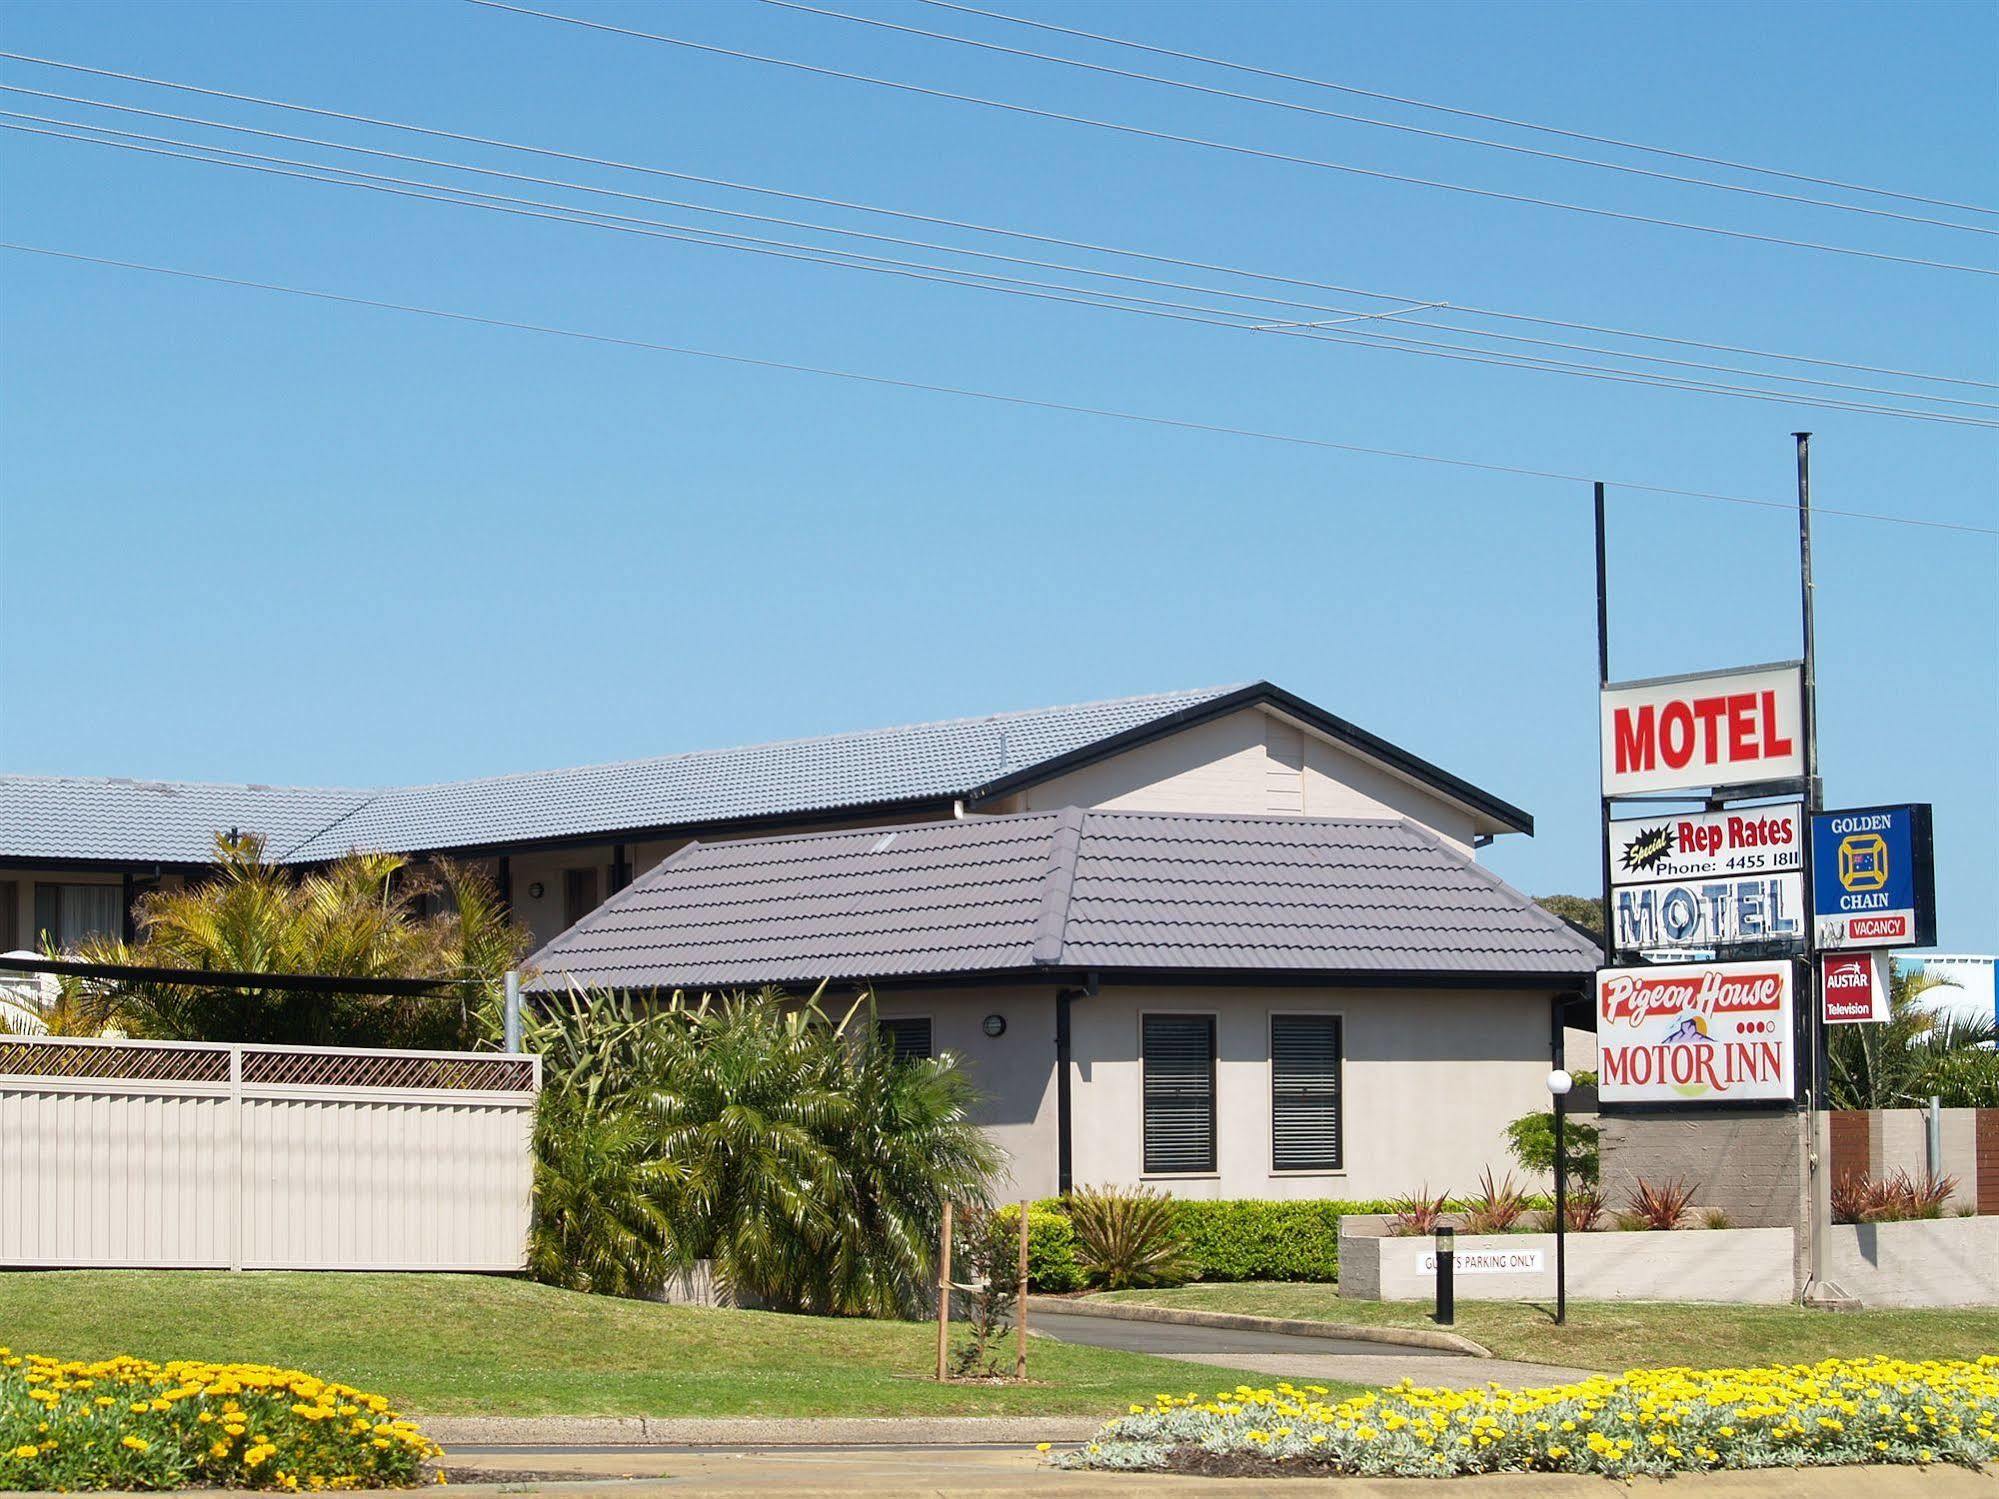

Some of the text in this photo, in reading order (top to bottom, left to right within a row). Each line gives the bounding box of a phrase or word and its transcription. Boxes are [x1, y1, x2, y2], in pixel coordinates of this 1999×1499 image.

[1614, 689, 1793, 775] MOTEL
[1677, 814, 1793, 857] Rep Rates
[1831, 814, 1892, 834] GOLDEN
[1629, 831, 1668, 865] Special
[1656, 852, 1798, 876] Phone: 4455 1811
[1618, 879, 1799, 944] MOTEL
[1839, 892, 1889, 910] CHAIN
[1853, 919, 1902, 936] VACANCY
[1827, 973, 1868, 988] AUSTAR
[1607, 971, 1784, 1028] Pigeon House
[1827, 1003, 1870, 1015] Television
[1601, 1041, 1783, 1091] MOTOR INN
[1465, 1255, 1506, 1268] PARKING
[1510, 1254, 1536, 1267] ONLY
